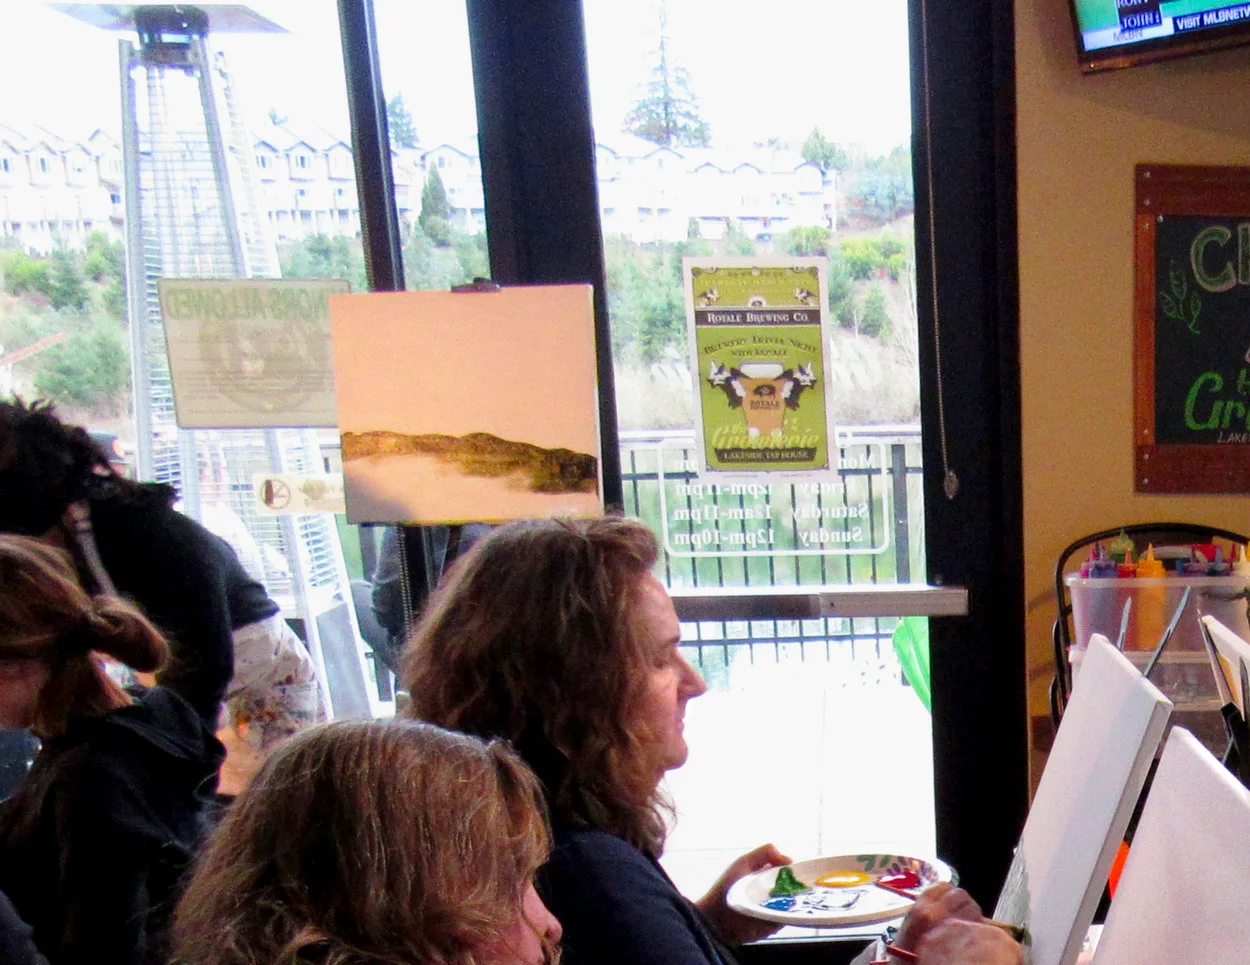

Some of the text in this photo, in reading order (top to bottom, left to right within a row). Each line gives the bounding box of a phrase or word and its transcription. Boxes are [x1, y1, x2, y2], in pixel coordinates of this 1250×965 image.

[1176, 16, 1201, 31] VISIT
[707, 312, 742, 325] ROYALE
[746, 312, 790, 324] BREWING
